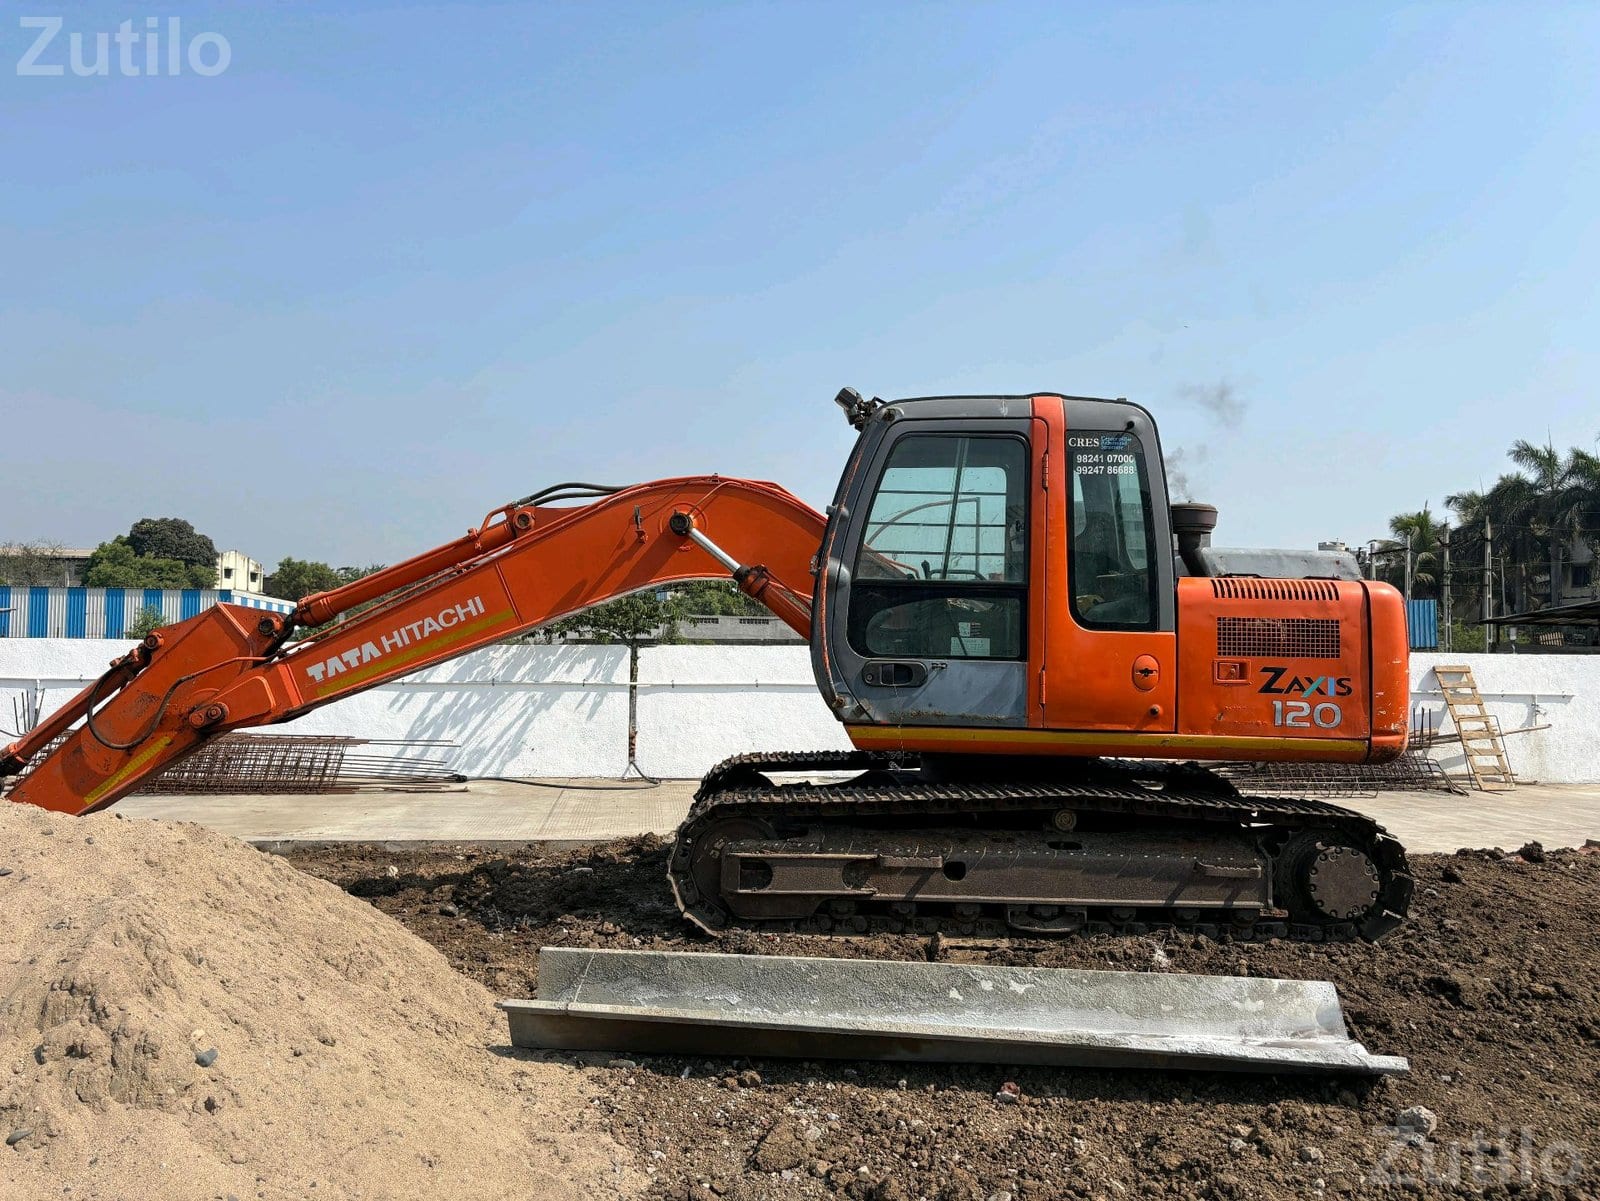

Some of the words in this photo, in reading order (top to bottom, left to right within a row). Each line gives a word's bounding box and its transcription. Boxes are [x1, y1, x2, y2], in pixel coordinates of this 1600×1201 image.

[1068, 437, 1100, 447] CRES
[1076, 454, 1104, 463] 98241
[1076, 466, 1105, 475] 99247
[1107, 466, 1135, 475] 86688
[306, 641, 382, 683] TATA
[380, 596, 486, 653] HITACHI
[1258, 666, 1353, 698] ZAXIS
[1272, 700, 1343, 729] 120
